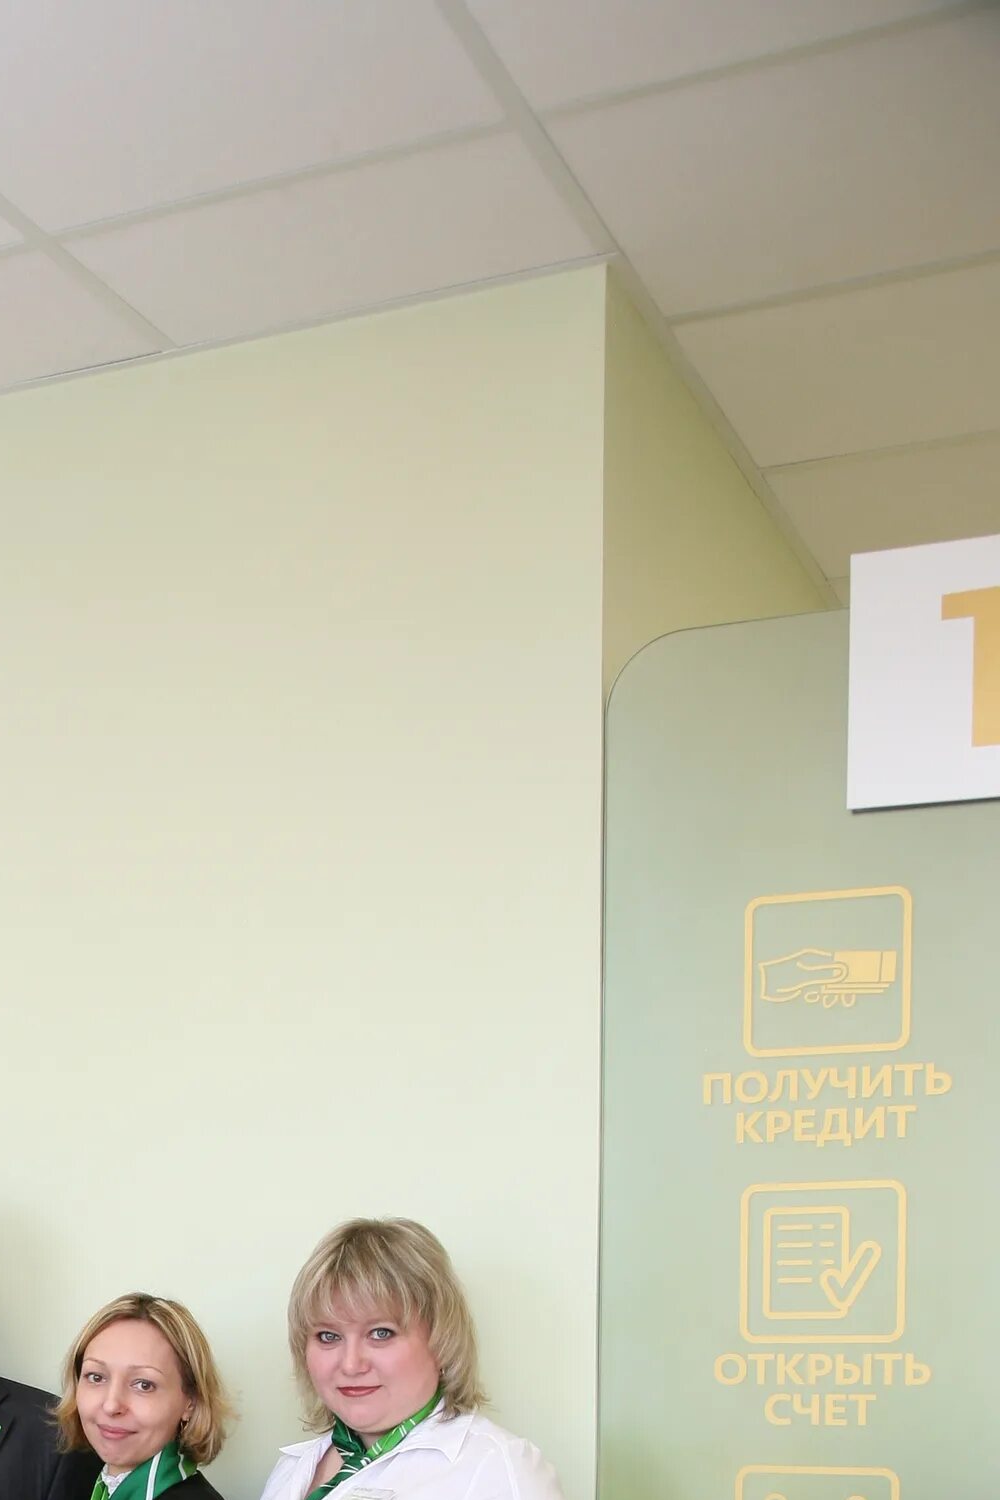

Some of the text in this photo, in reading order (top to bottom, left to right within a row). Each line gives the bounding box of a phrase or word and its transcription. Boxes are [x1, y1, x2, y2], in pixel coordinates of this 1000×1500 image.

[703, 1062, 953, 1105] ПОЛУЧИТЬ
[735, 1104, 918, 1147] КРЕДИТ
[713, 1352, 932, 1387] ОТКРЫТЬ
[764, 1392, 877, 1427] СЧЕТ
